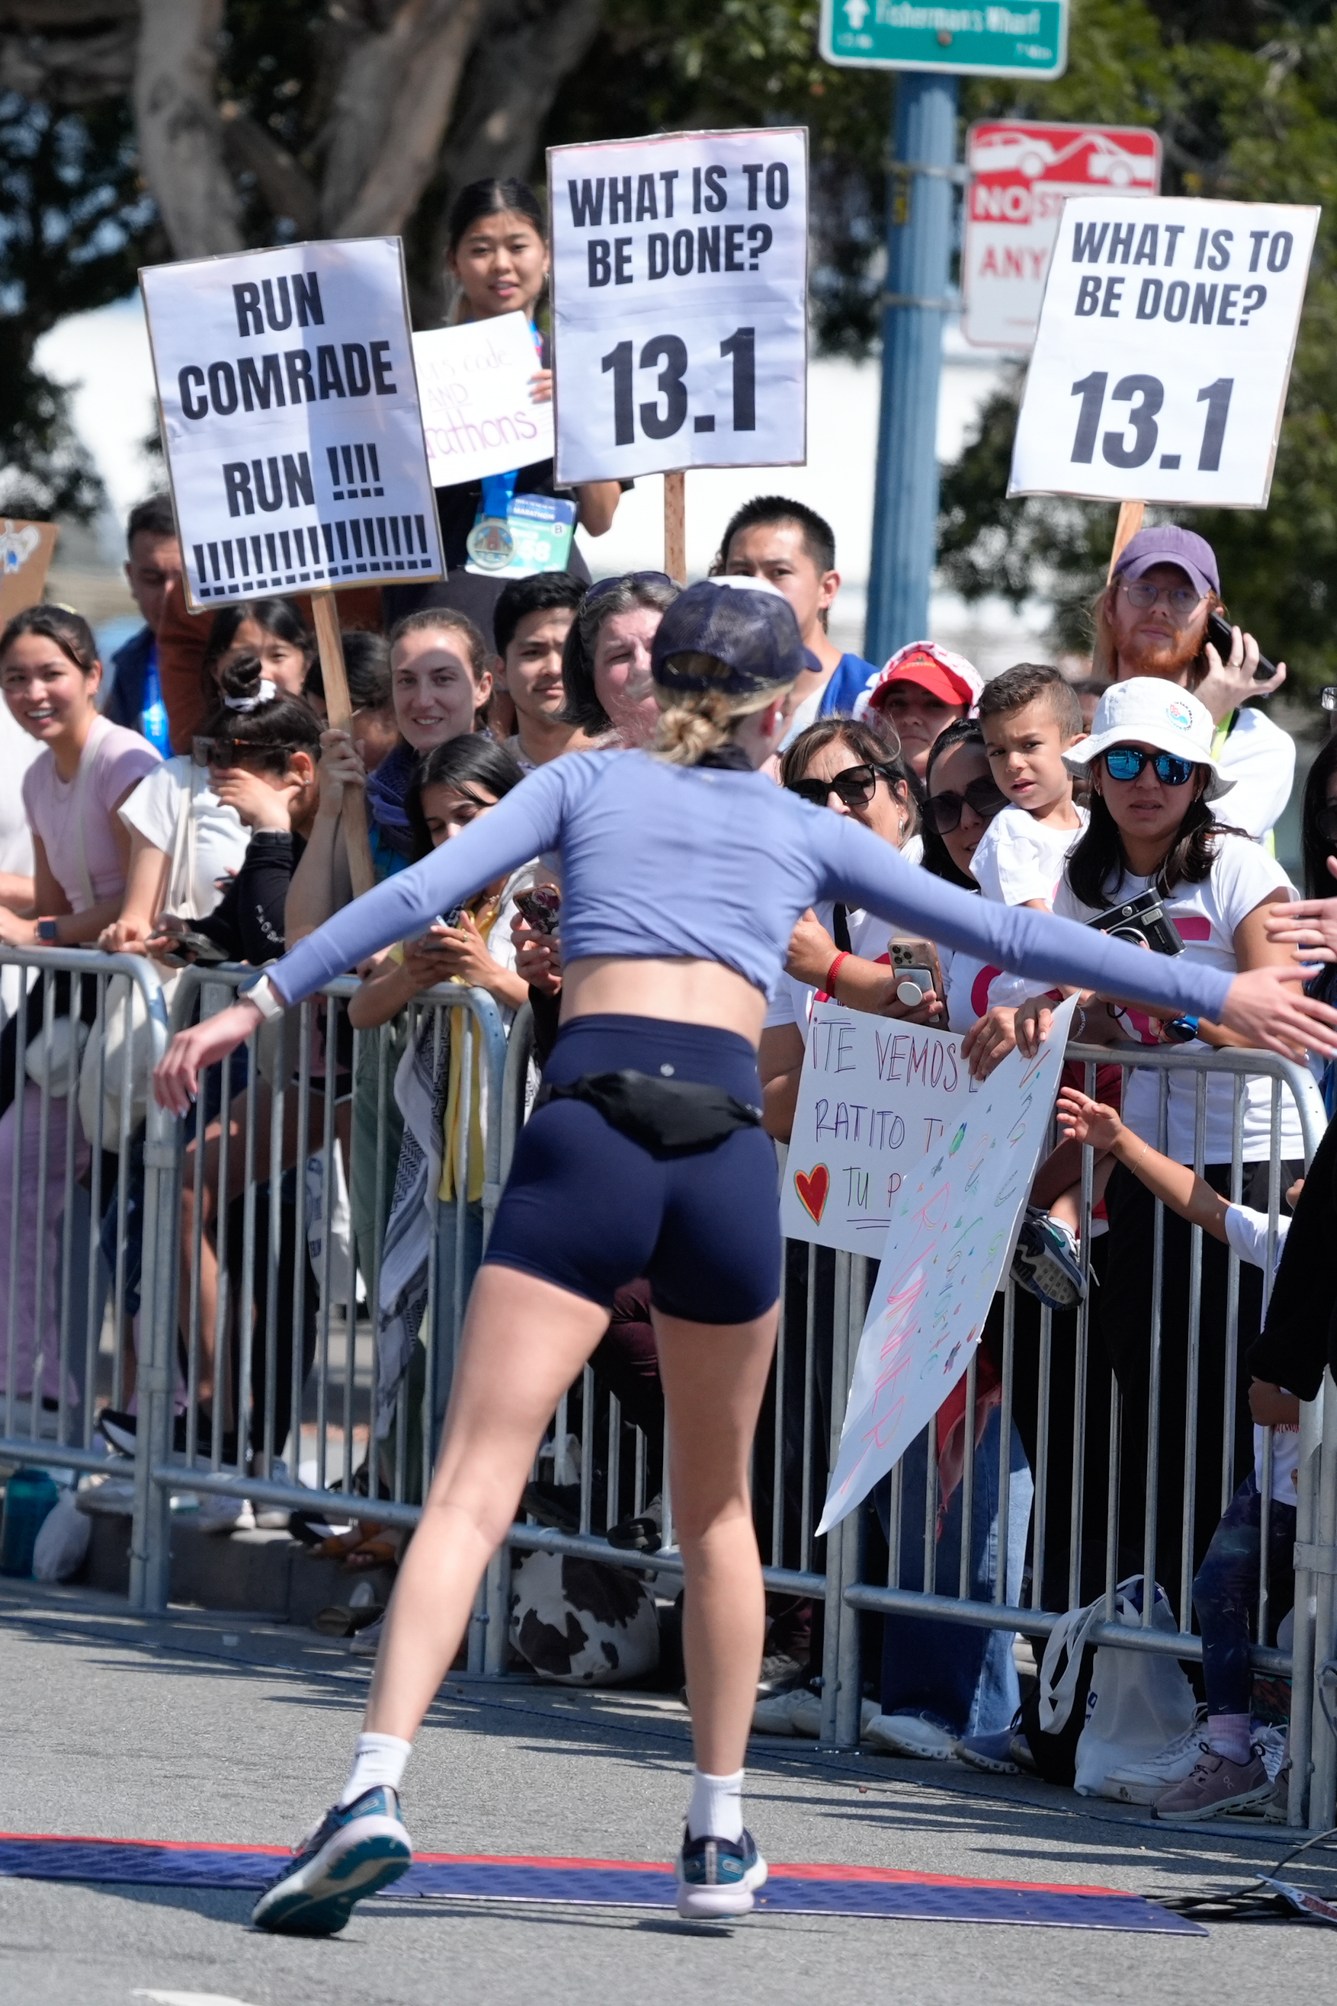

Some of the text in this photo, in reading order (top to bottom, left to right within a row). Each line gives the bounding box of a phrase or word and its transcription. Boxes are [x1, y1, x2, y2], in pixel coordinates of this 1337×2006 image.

[985, 6, 1041, 34] Wharf
[567, 162, 789, 227] WHAT IS TO
[973, 184, 1029, 220] NO
[587, 223, 773, 287] BE DONE?
[980, 246, 1046, 280] ANY
[1071, 222, 1294, 273] WHAT IS TO
[232, 271, 325, 337] RUN
[1074, 275, 1267, 326] BE DONE?
[177, 340, 397, 420] COMRADE
[463, 337, 513, 373] code
[427, 383, 469, 409] AND
[601, 327, 756, 446] 13.1
[425, 408, 537, 459] rathons
[1070, 371, 1235, 472] 13.1
[222, 443, 384, 517] RUN !!!!
[875, 1030, 958, 1093] VEMOS
[815, 1099, 905, 1150] RATITO
[842, 1166, 869, 1210] TU
[840, 1182, 950, 1494] RUNNER
